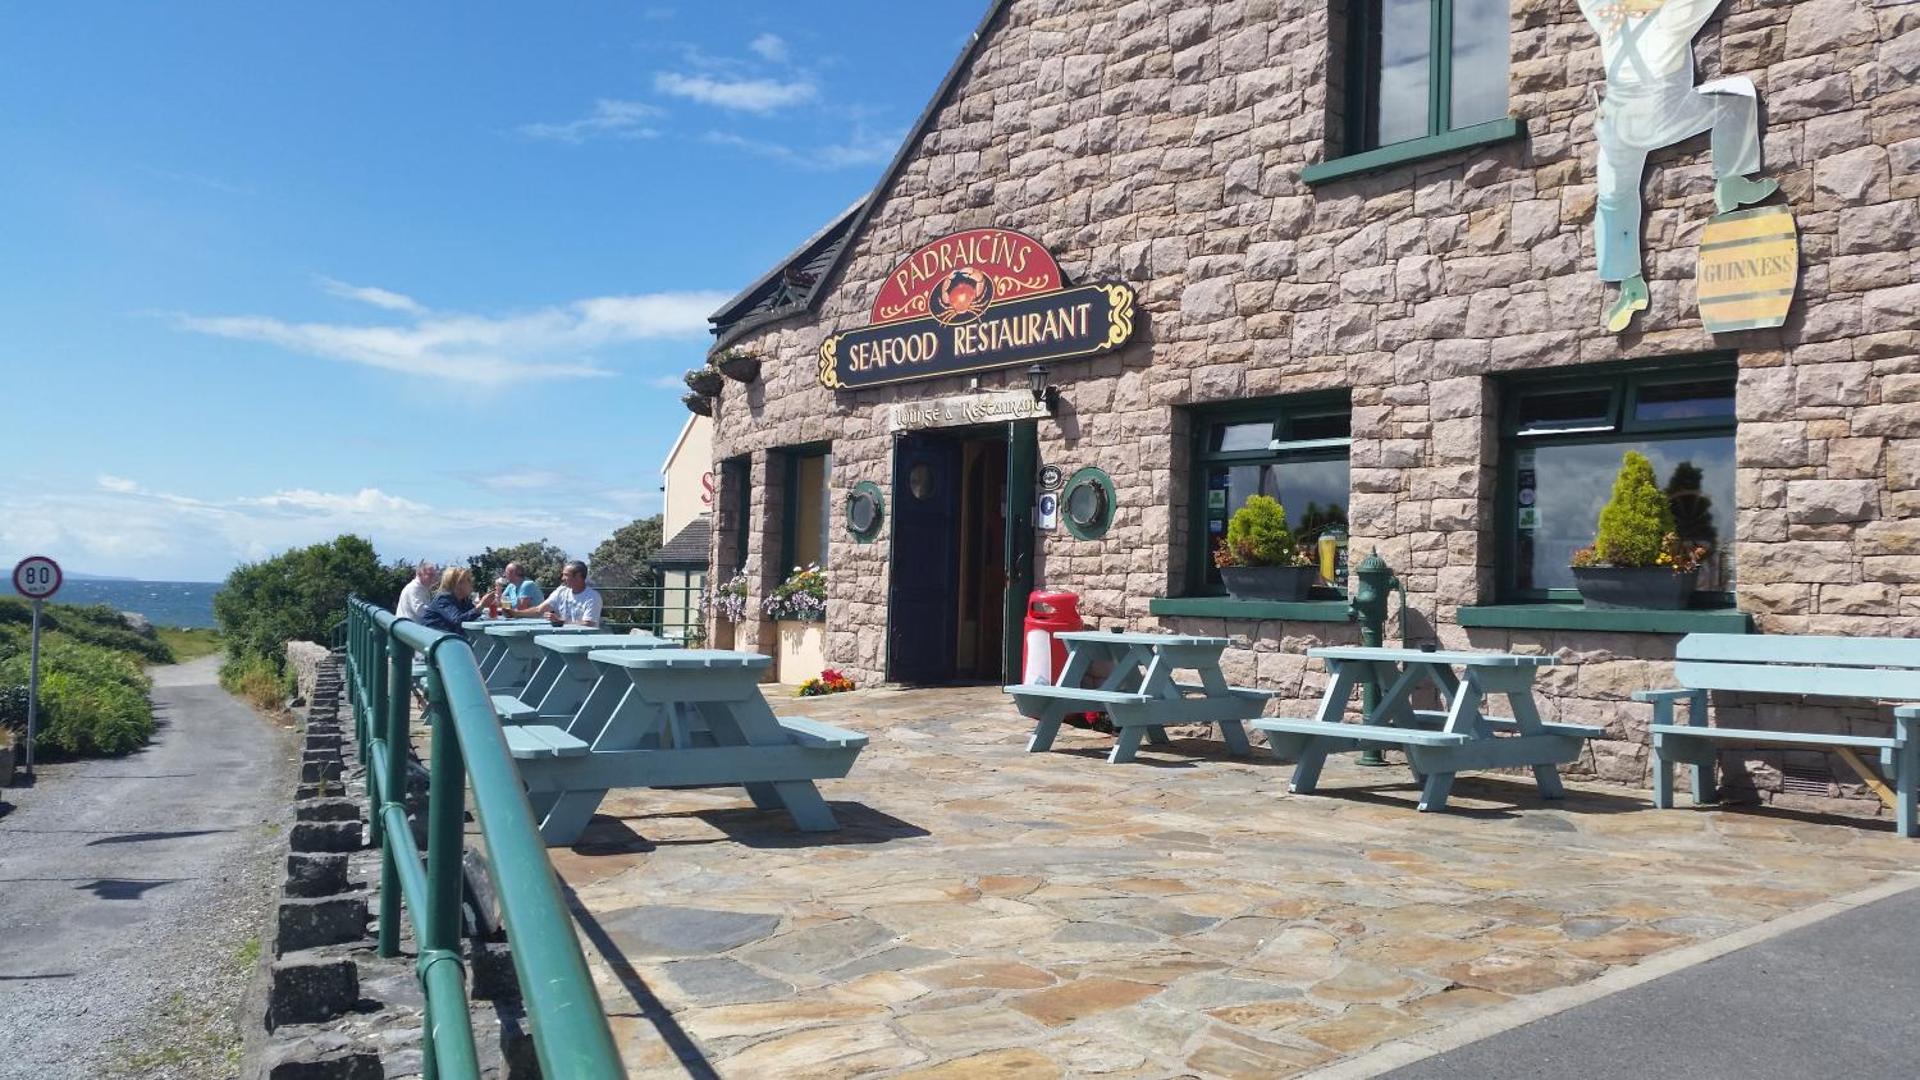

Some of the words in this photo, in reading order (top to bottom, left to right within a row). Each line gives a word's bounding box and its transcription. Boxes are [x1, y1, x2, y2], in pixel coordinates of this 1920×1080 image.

[1703, 255, 1793, 283] GUINNESS
[849, 331, 939, 372] SEAFOOD
[954, 303, 1092, 357] RESTAURANT
[26, 567, 49, 584] 80
